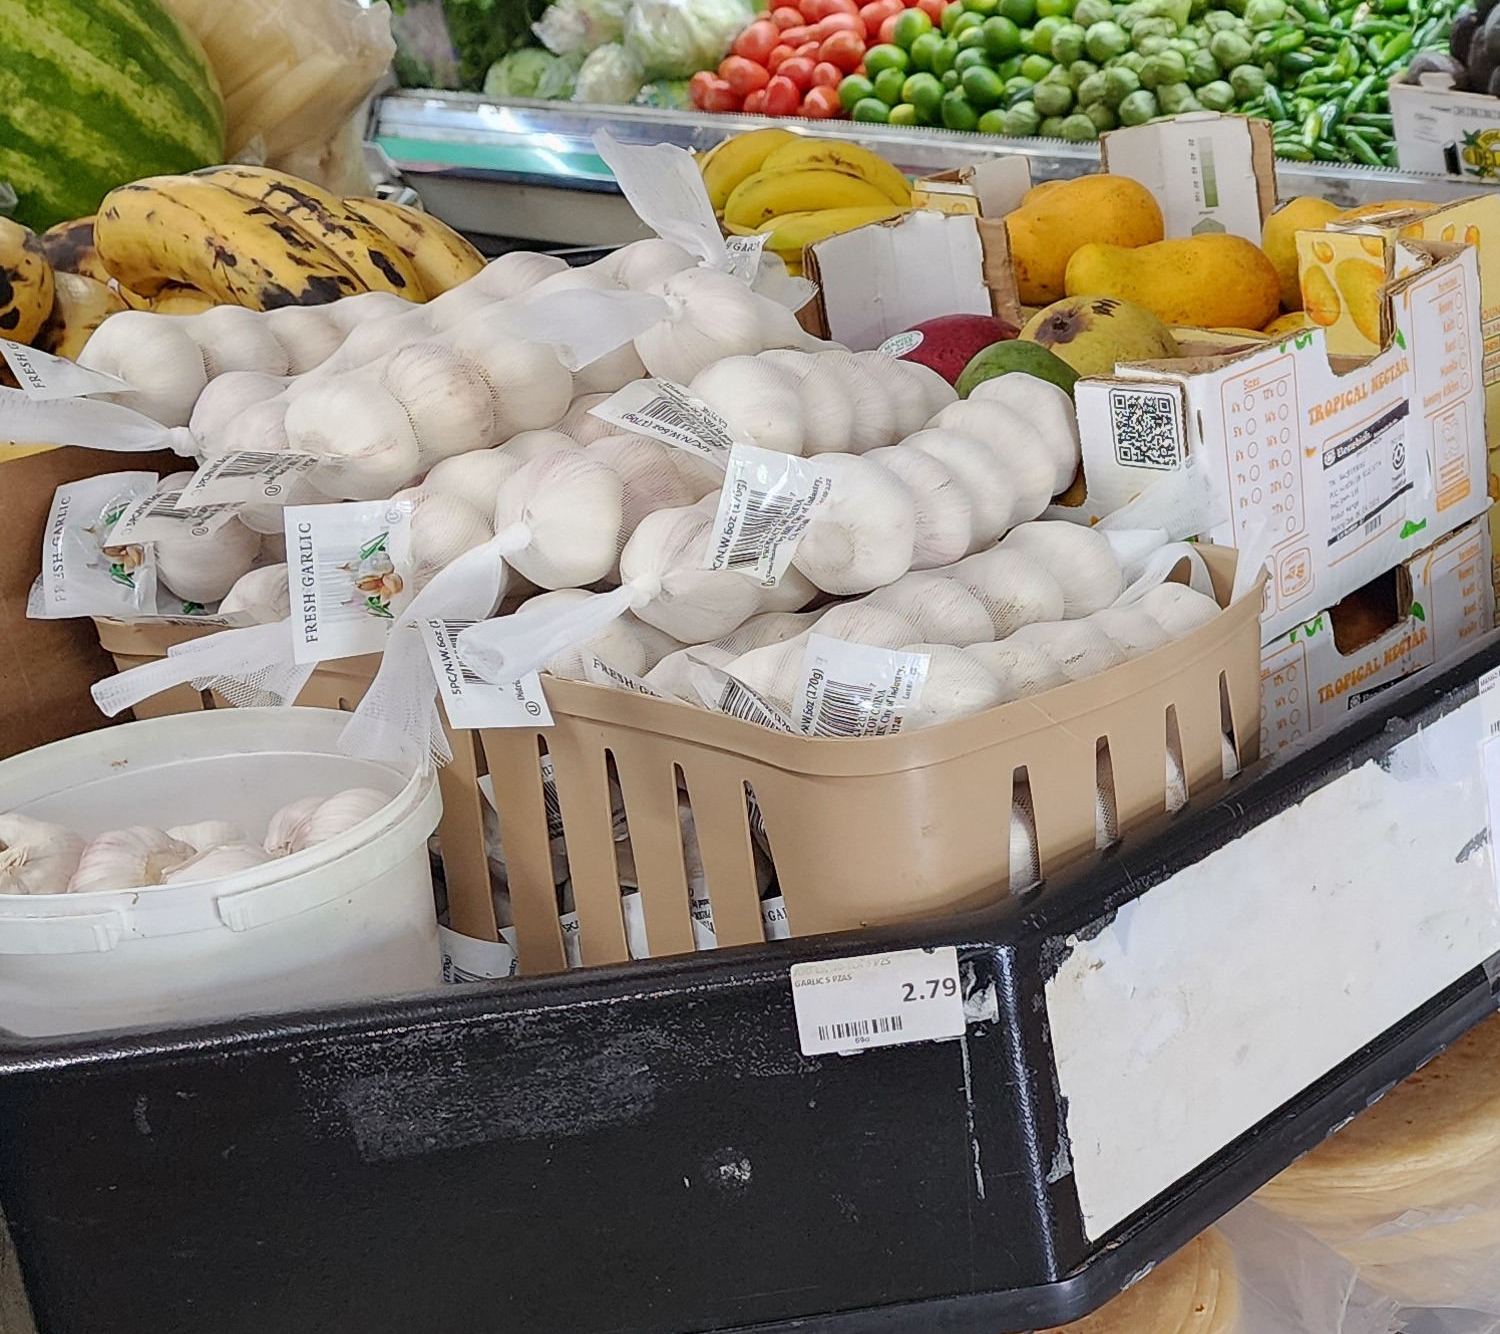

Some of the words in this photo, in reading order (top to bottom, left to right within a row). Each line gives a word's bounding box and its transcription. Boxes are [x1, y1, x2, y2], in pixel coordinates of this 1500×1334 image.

[14, 351, 46, 391] FRESH
[1307, 385, 1369, 428] TROPICAL
[1370, 356, 1411, 394] NECTAR
[52, 495, 73, 549] GARLIC
[298, 522, 315, 589] GARLIC
[303, 592, 319, 644] FRESH
[592, 656, 636, 691] FRESH
[1316, 659, 1381, 705] TROPICAL
[1383, 626, 1429, 668] NECTAR
[794, 975, 825, 988] GARLIC
[832, 972, 854, 984] PZAS
[901, 977, 957, 1003] 2.79
